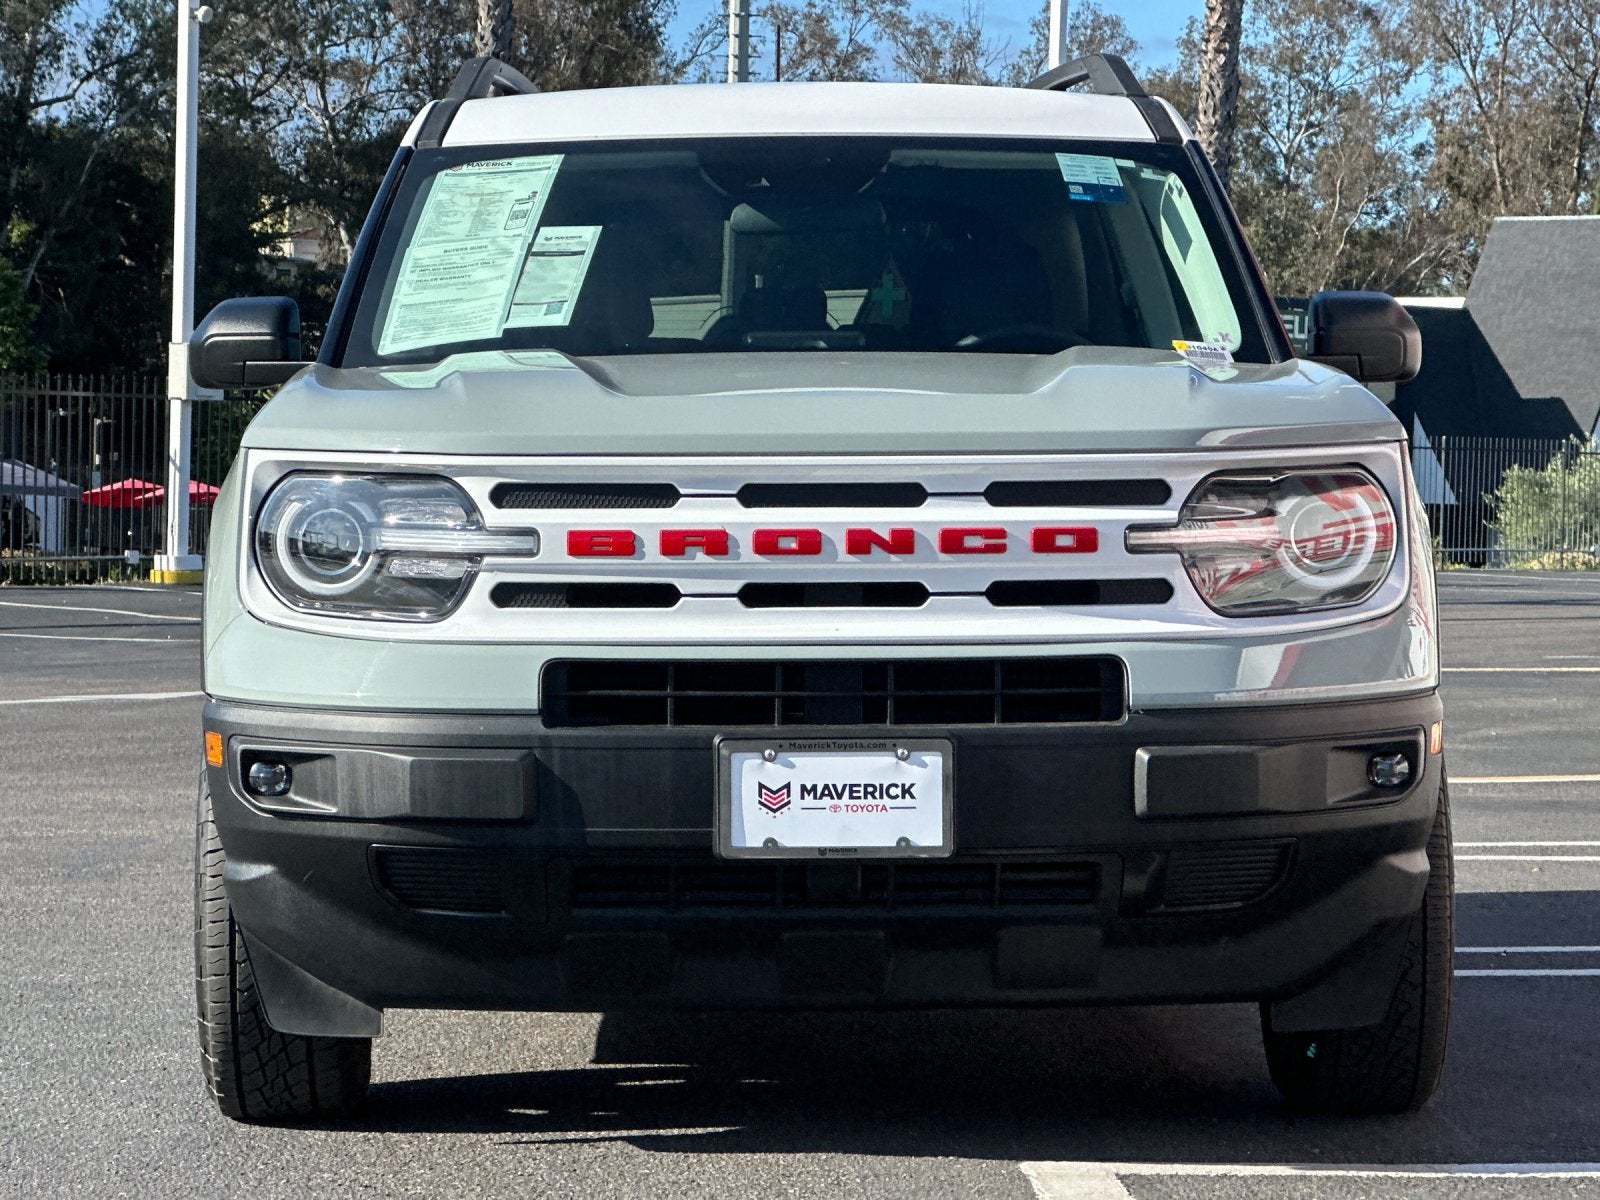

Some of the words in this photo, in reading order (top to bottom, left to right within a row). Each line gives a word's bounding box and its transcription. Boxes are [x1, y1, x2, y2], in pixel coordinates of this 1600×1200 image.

[466, 160, 514, 168] MAVERICK
[566, 527, 1099, 557] BRONCO
[788, 741, 887, 750] MaverickToyota.com
[800, 783, 916, 800] MAVERICK
[844, 804, 888, 813] TOYOTA
